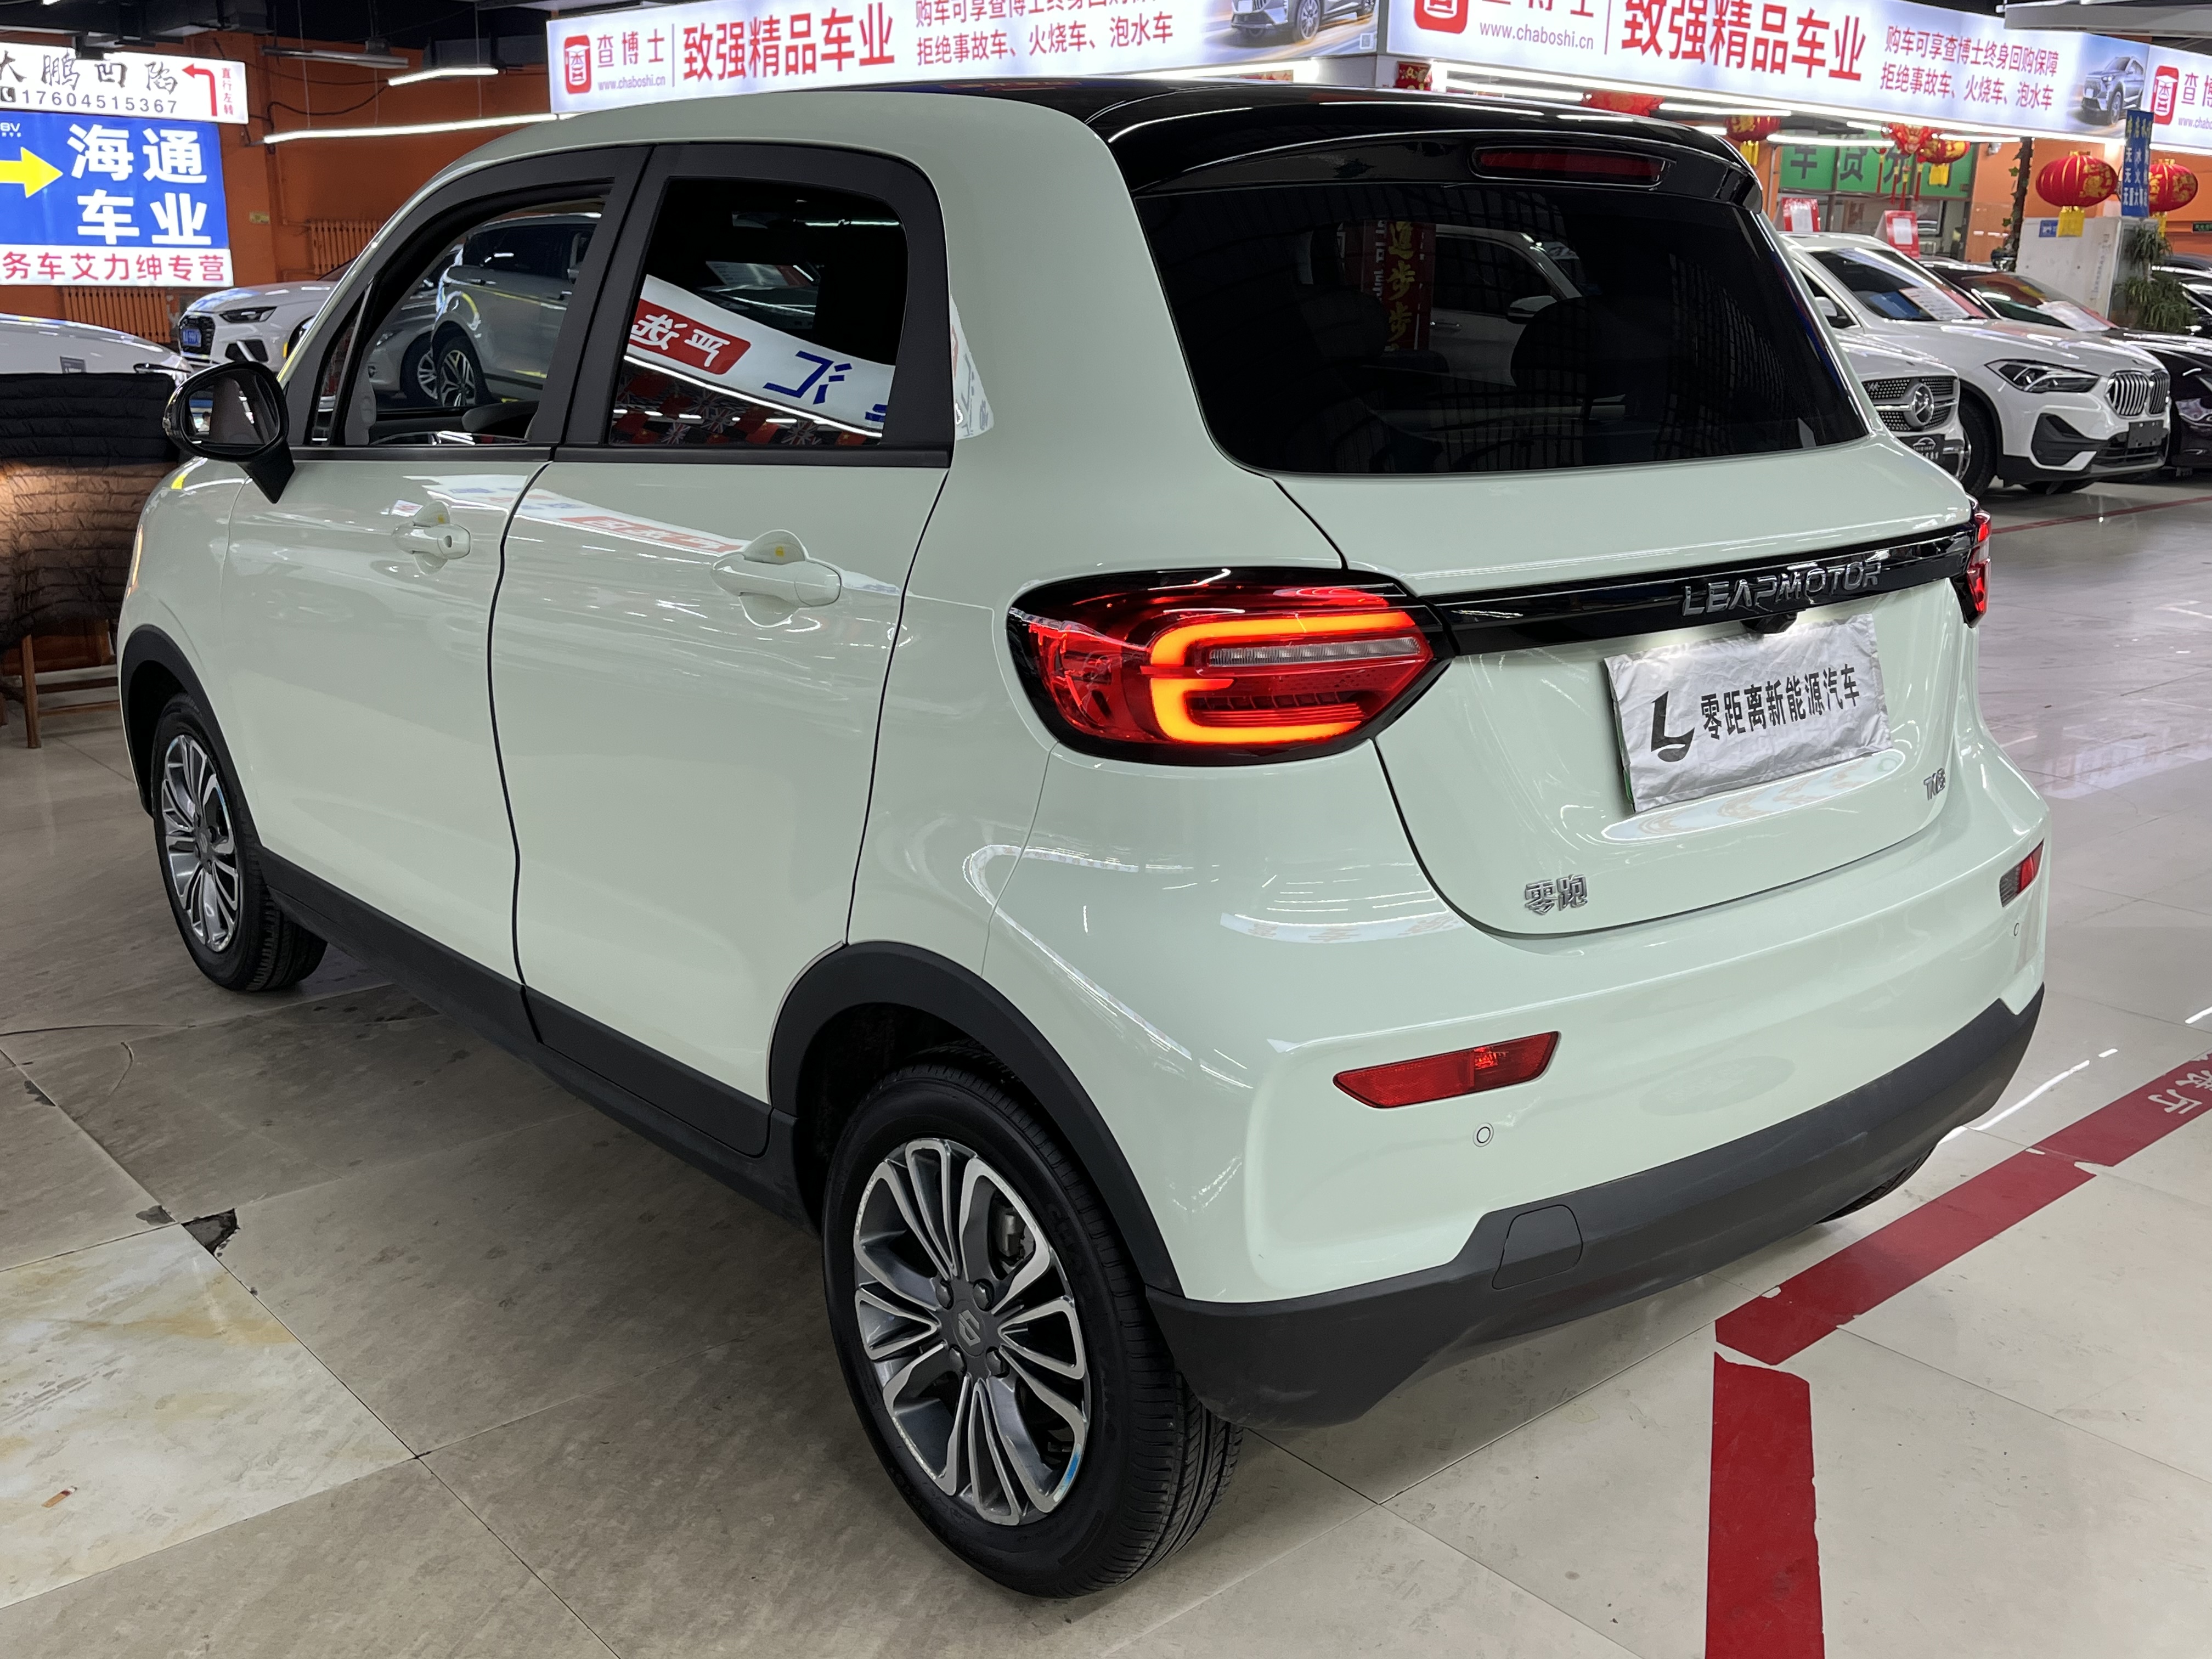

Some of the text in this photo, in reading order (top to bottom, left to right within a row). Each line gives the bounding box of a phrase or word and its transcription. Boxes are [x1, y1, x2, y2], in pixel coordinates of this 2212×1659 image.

[597, 29, 665, 68] 查博士
[683, 3, 895, 82] 致强精品车业
[1480, 22, 1594, 49] www.chaboshi.cn
[1622, 0, 1866, 81] 致强精品车业
[1884, 26, 2059, 77] 购车可享查博士终身回购保障
[22, 89, 177, 114] 17604515367
[598, 75, 665, 91] www.chaboshi.cn
[67, 123, 207, 184] 海通
[77, 189, 212, 245] 车业
[2, 251, 224, 283] 务车艾力绅专营
[1681, 560, 1883, 617] LEAPMOTOR
[1700, 664, 1860, 740] 零距离新能源汽车
[1524, 874, 1588, 915] 零跑
